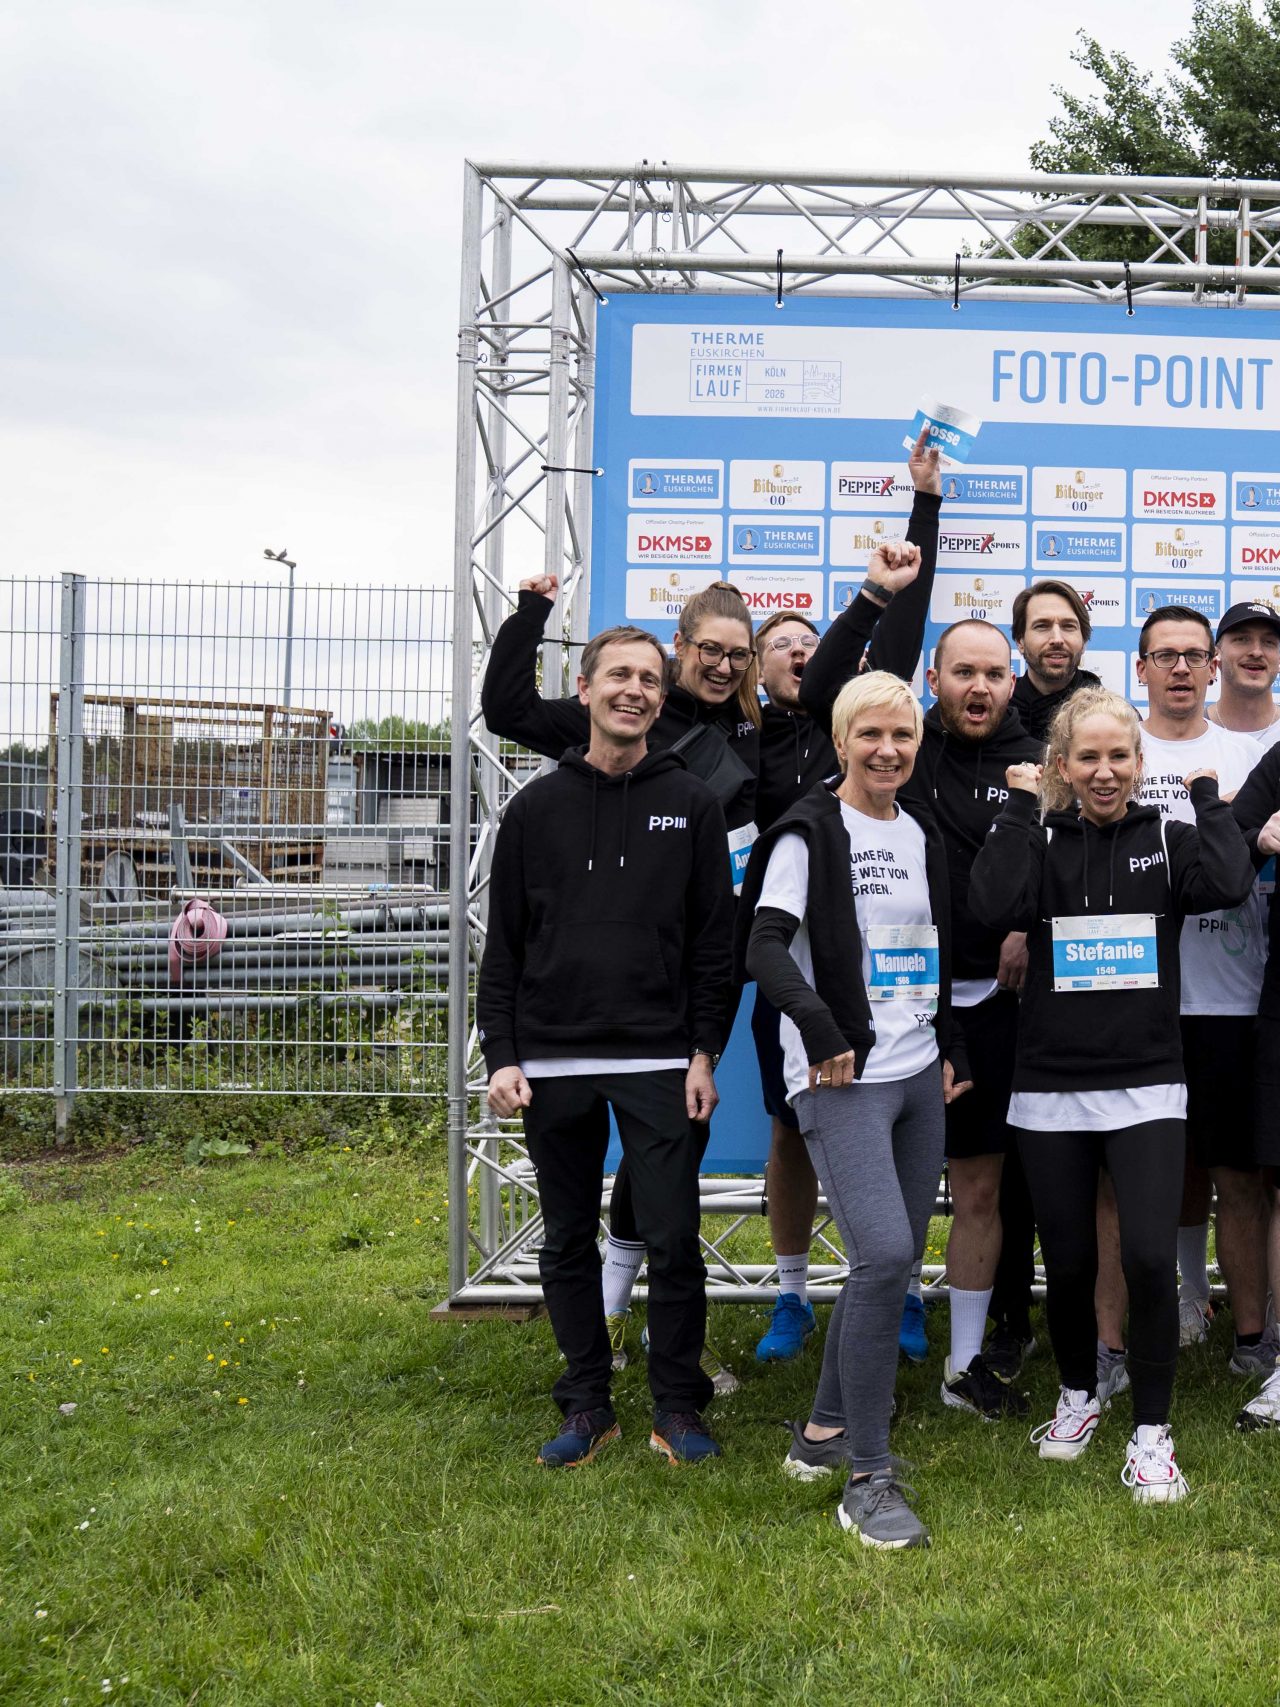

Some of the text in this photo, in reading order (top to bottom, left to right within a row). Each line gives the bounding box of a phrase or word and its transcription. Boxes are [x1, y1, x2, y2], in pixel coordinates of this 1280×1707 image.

[690, 332, 765, 346] THERME
[690, 347, 766, 358] EUSKIRCHEN
[696, 364, 742, 377] FIRMEN
[764, 365, 787, 378] KÖLN
[992, 349, 1274, 411] FOTO-POINT
[695, 380, 742, 398] LAUF
[764, 388, 786, 399] 2026
[663, 474, 714, 486] THERME
[967, 480, 1017, 491] THERME
[663, 485, 714, 495] EUSKIRCHEN
[753, 479, 803, 496] Bitburger
[890, 485, 915, 493] SPORT
[1055, 484, 1104, 502] Bitburger
[967, 490, 1018, 499] EUSKIRCHEN
[1143, 491, 1199, 508] DKMS
[763, 531, 814, 542] THERME
[1066, 536, 1117, 548] THERME
[638, 535, 694, 552] DKMS
[763, 541, 815, 550] EUSKIRCHEN
[990, 542, 1020, 550] SPORTS
[1154, 541, 1204, 558] Bitburger
[1066, 547, 1117, 556] EUSKIRCHEN
[745, 592, 795, 608] DKMS
[953, 591, 1003, 609] Bitburger
[1090, 599, 1120, 607] SPORTS
[1165, 593, 1216, 604] THERME
[1160, 774, 1183, 786] FÜR
[1139, 789, 1189, 800] WELT VO
[850, 848, 896, 864] UME FÜR
[859, 866, 886, 879] WELT
[887, 867, 910, 880] VON
[852, 883, 893, 897] ORGEN.
[1065, 940, 1146, 963] Stefanie
[875, 952, 927, 973] Manuela
[1095, 965, 1118, 976] 1549
